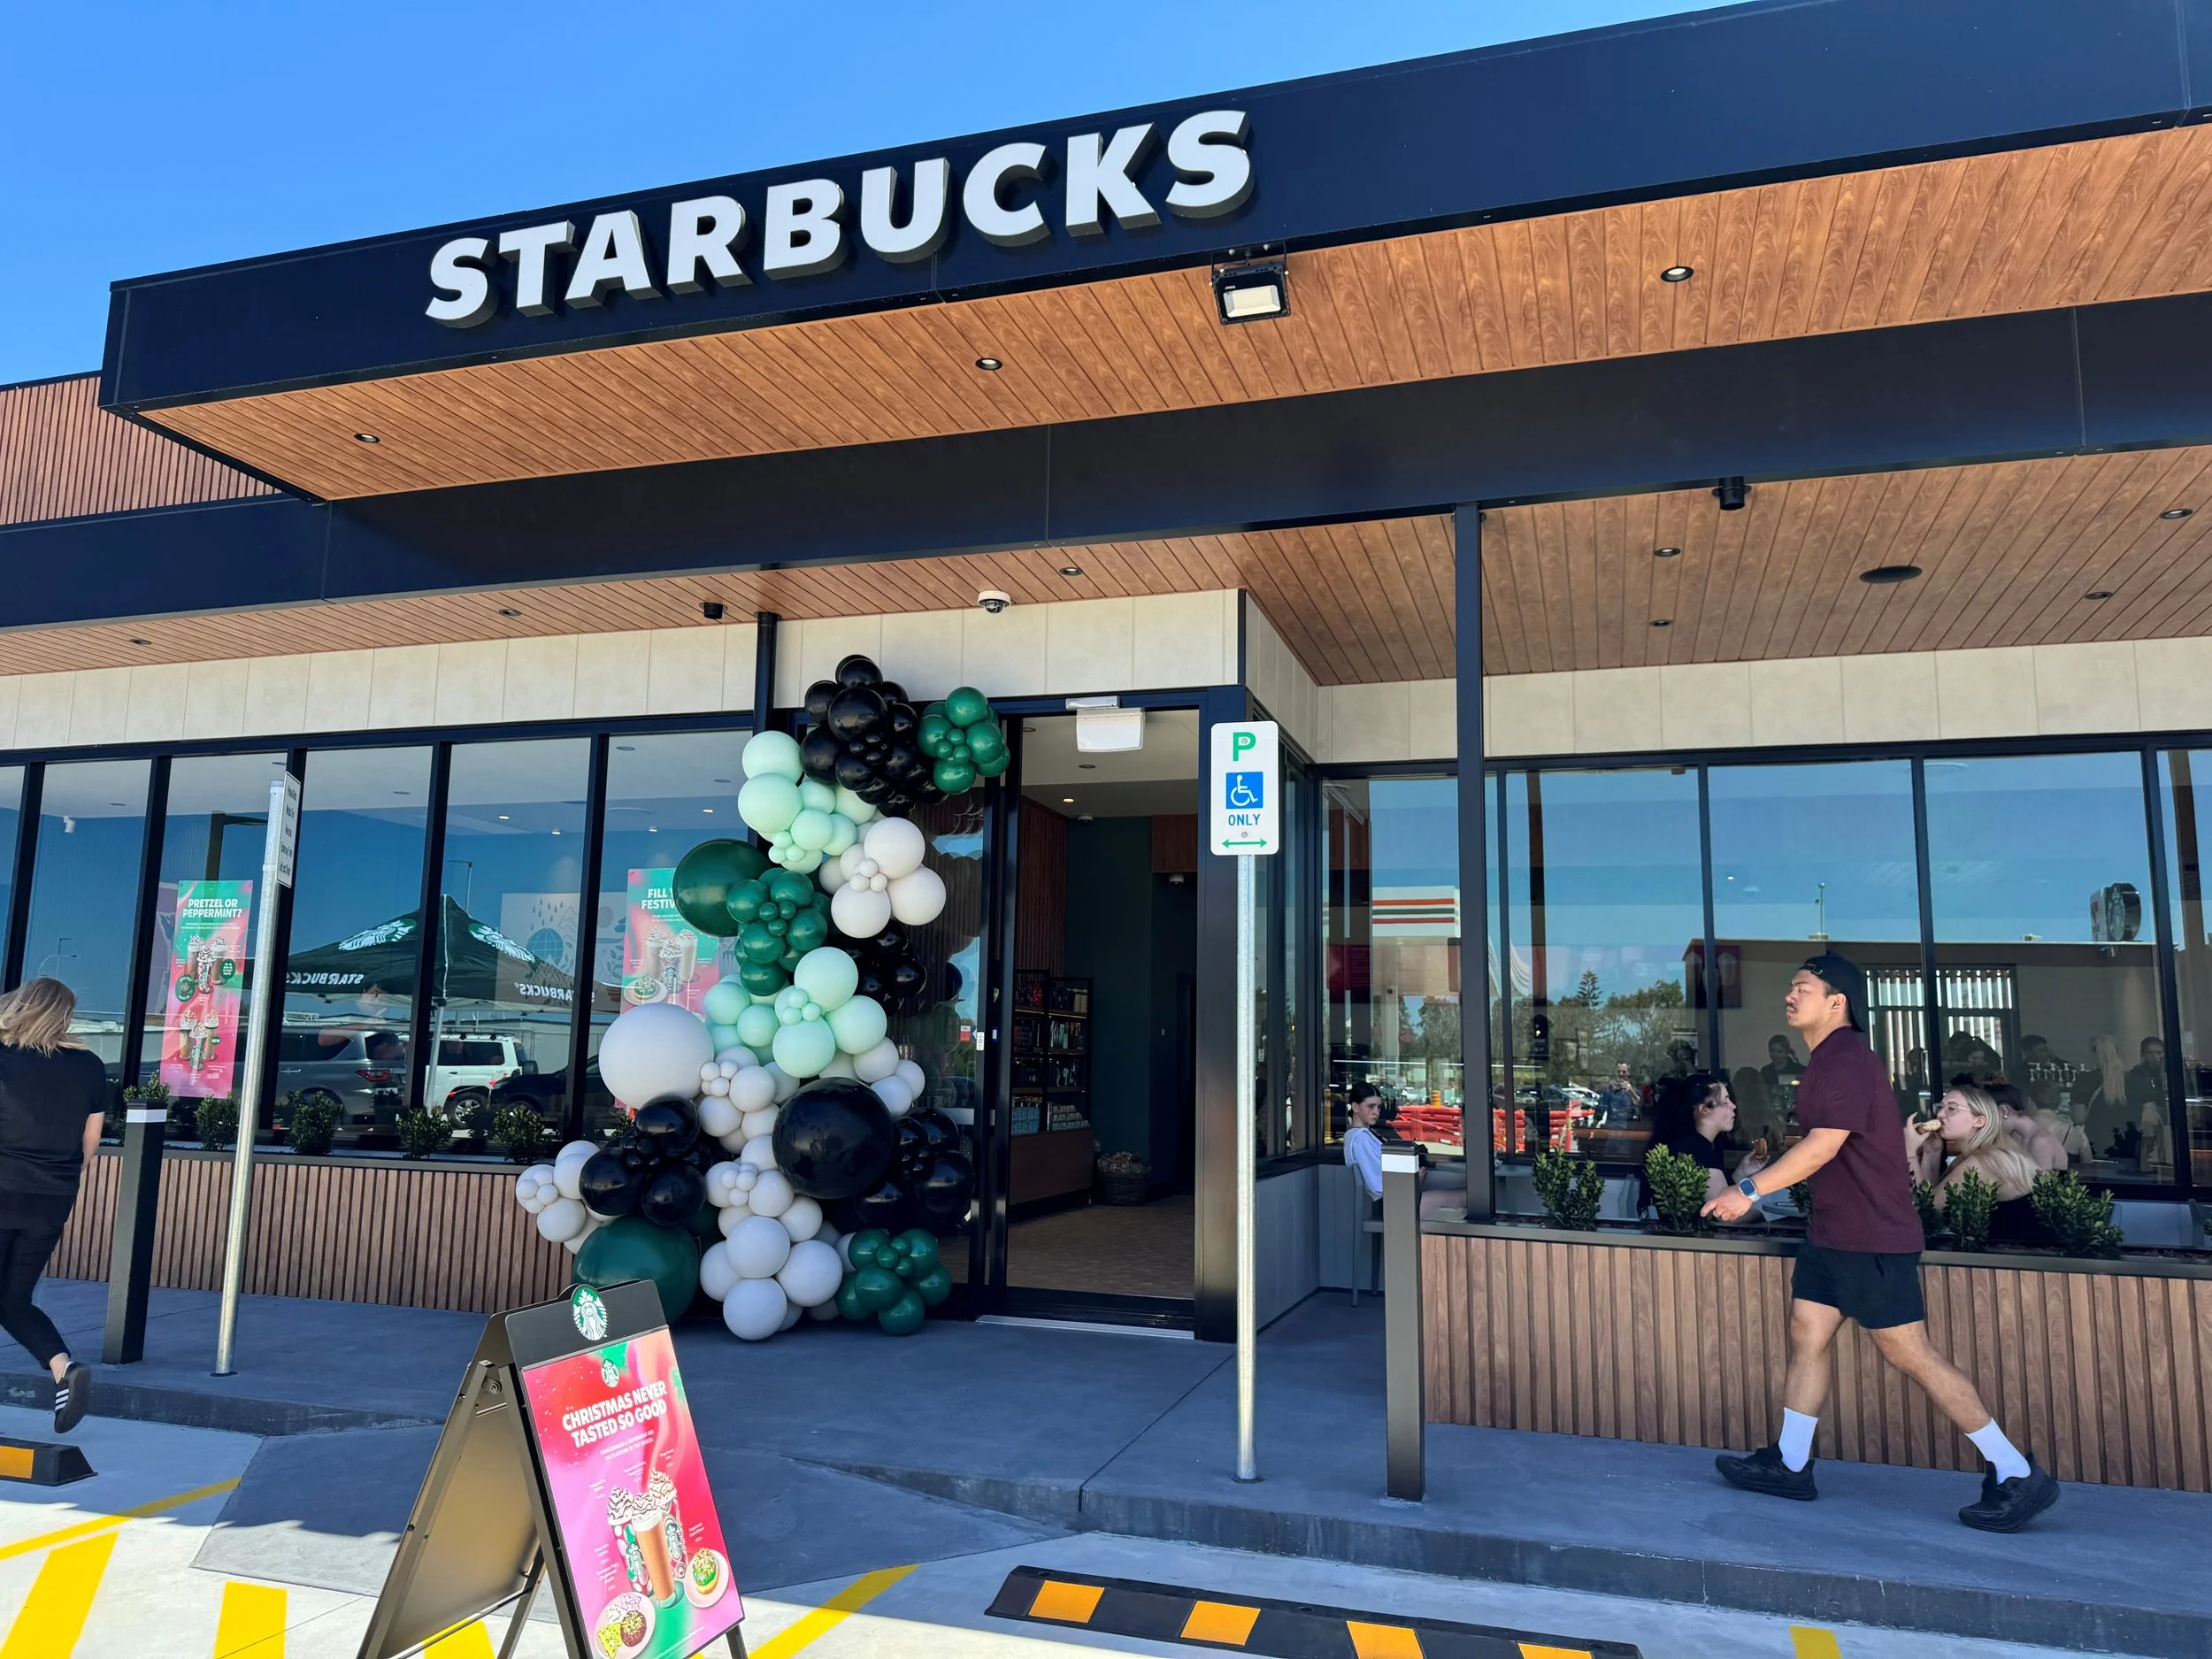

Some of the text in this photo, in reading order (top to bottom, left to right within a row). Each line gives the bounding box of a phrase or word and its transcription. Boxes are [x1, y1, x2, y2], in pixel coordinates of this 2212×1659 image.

[424, 110, 1253, 327] STARBUCKS
[1233, 732, 1256, 761] P
[1228, 814, 1260, 826] ONLY
[648, 888, 667, 898] FILL
[188, 898, 238, 908] PRETZEL OR
[641, 899, 676, 910] FESTIV
[182, 909, 242, 918] PEPPERMINT?
[563, 1380, 667, 1431] CHRISTMAS NEVER
[571, 1399, 667, 1448] TASTED SO GOOD
